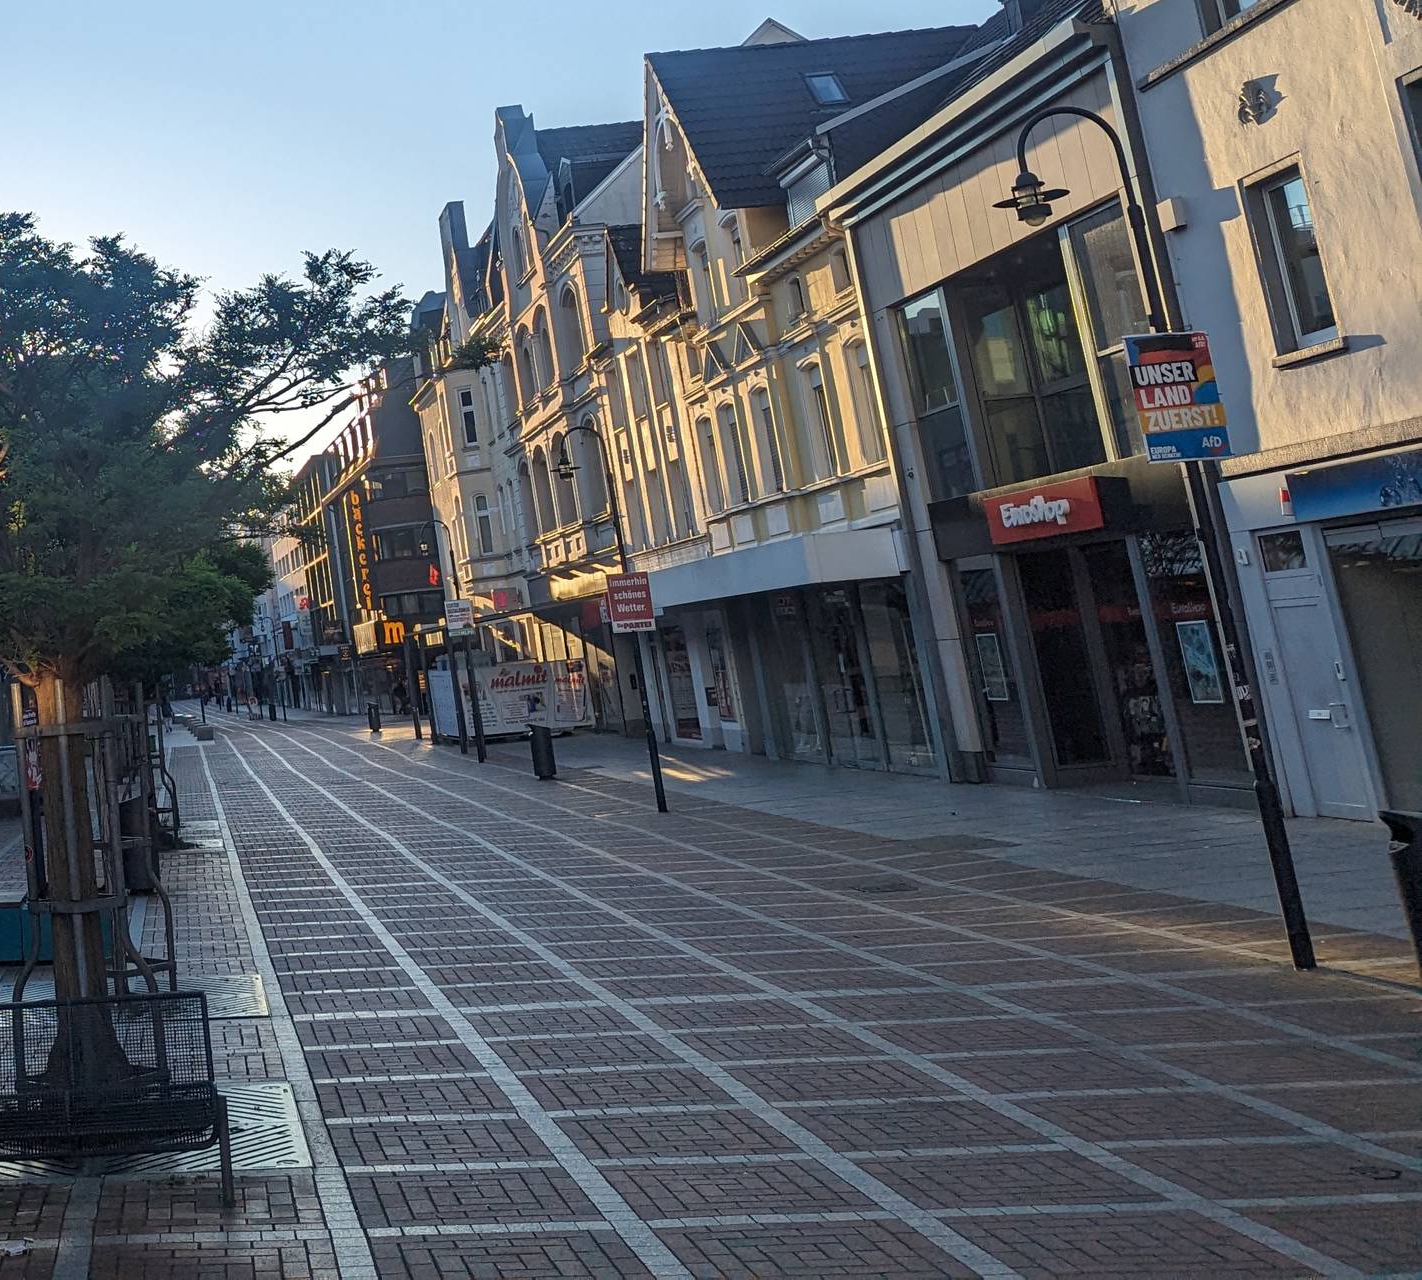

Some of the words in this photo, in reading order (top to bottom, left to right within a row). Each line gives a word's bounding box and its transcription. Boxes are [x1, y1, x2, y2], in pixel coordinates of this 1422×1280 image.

[1134, 361, 1196, 386] UNSER
[1140, 385, 1191, 409] LAND
[1146, 405, 1219, 432] ZUERST!
[1202, 436, 1222, 448] AfD
[613, 589, 647, 600] schönes
[616, 603, 647, 613] Wetter.
